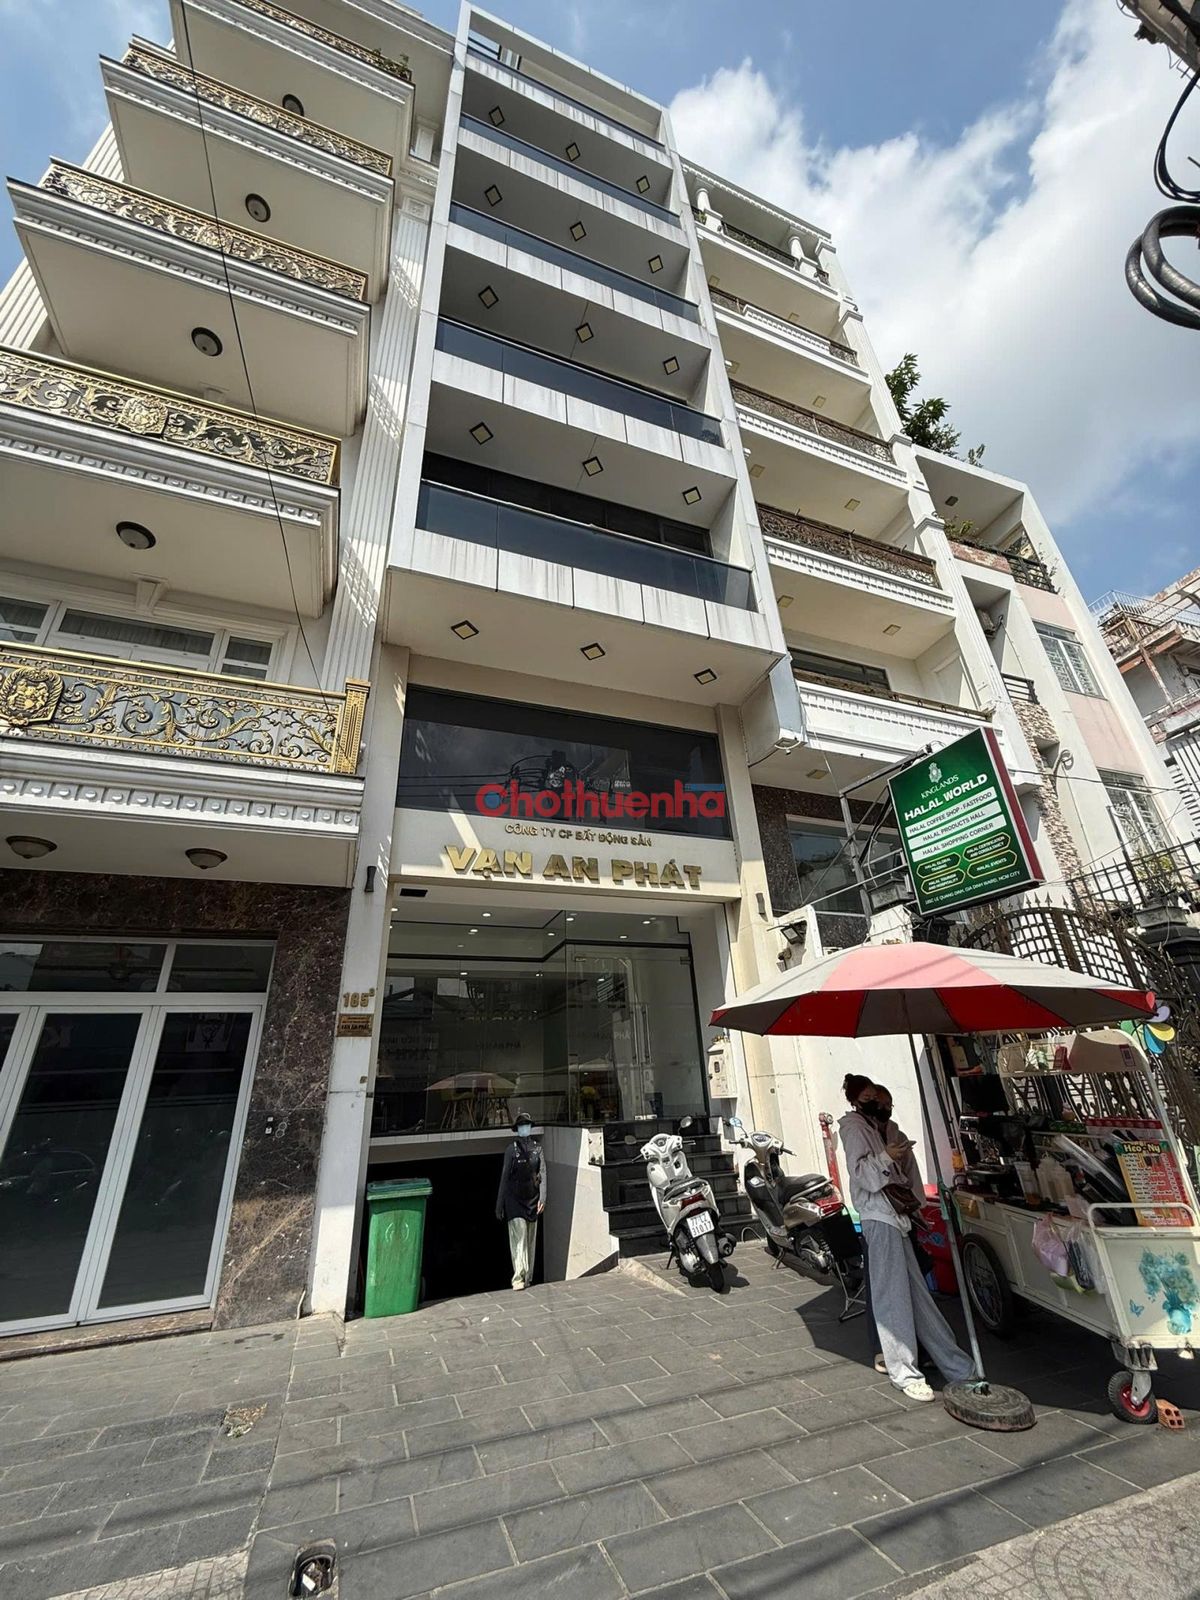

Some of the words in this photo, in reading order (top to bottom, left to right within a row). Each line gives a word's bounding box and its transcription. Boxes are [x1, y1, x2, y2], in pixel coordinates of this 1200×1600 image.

[904, 798, 943, 821] HALAL
[943, 773, 988, 801] WORLD
[920, 774, 959, 799] KINGLANDS
[909, 824, 926, 833] HALAL
[926, 814, 945, 826] COFFEE
[945, 807, 960, 817] SHOP
[962, 792, 992, 809] FASTFOOD
[922, 831, 940, 841] HALAL
[940, 817, 970, 833] PRODUCTS
[970, 811, 985, 820] HALL
[505, 823, 538, 836] CÔNG
[541, 827, 556, 837] TY
[558, 829, 573, 839] CP
[575, 828, 597, 841] BẤT
[598, 831, 628, 845] ĐỘNG
[630, 833, 652, 847] SẢN
[922, 846, 940, 856] HALAL
[940, 833, 969, 848] SHOPPING
[969, 823, 993, 836] CORNER
[444, 845, 534, 880] VẠN
[543, 854, 600, 884] AN
[611, 858, 701, 891] PHÁT
[976, 863, 990, 871] HALAL
